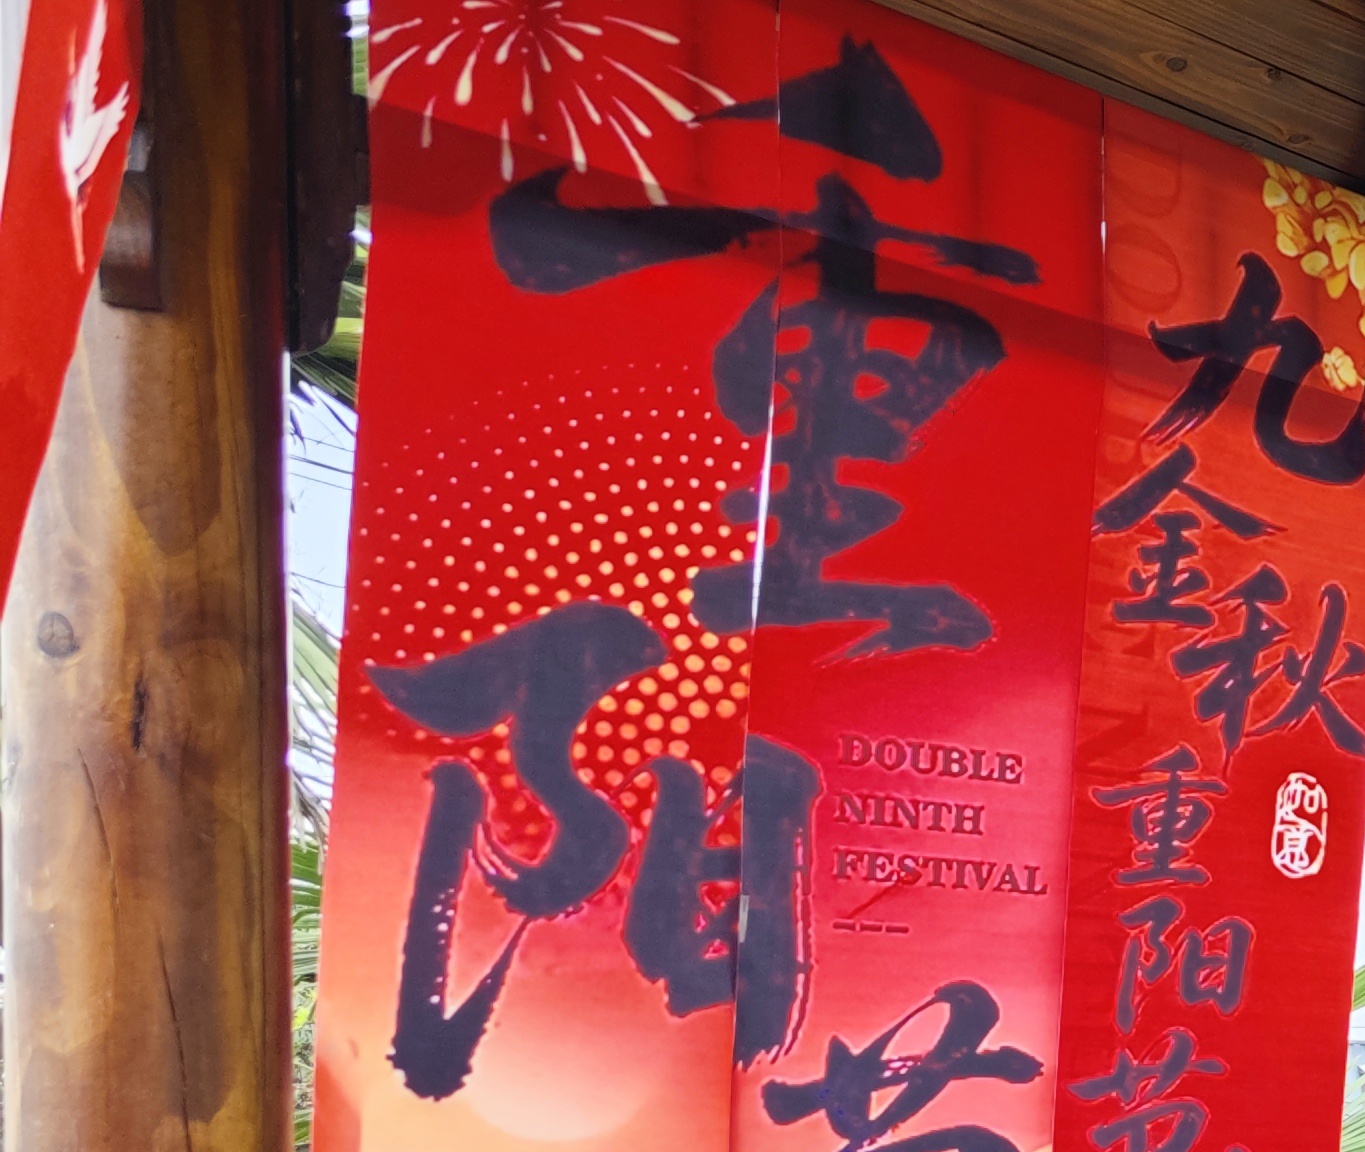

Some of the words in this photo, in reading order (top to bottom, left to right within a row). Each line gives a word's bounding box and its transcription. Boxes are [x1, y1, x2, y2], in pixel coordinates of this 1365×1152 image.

[839, 733, 1024, 784] DOUBLE
[835, 793, 985, 835] NINTH
[833, 847, 1048, 894] FESTIVAL
